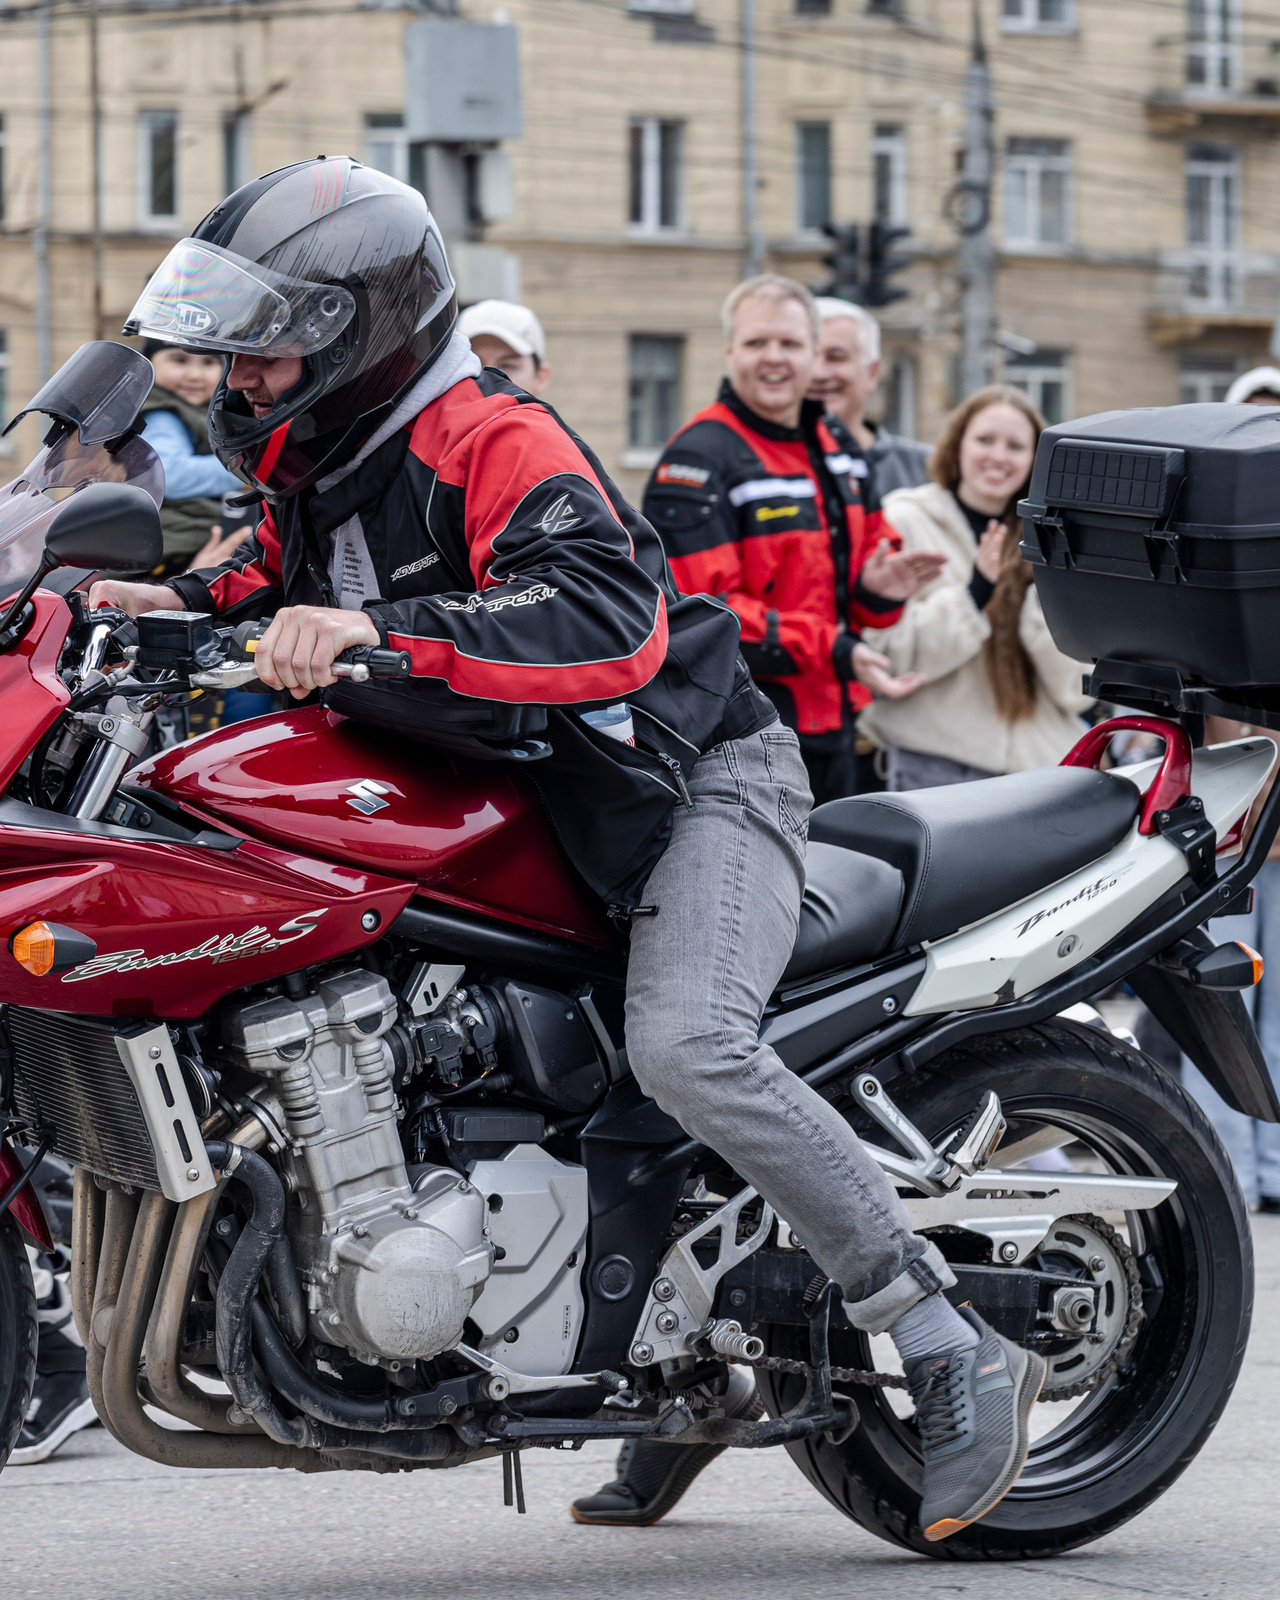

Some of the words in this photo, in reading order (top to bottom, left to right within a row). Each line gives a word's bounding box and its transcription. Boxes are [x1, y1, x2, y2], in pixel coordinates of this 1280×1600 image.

[1087, 879, 1118, 901] 1250
[61, 925, 272, 982] Bandit
[261, 907, 329, 948] S
[211, 942, 280, 966] 1250
